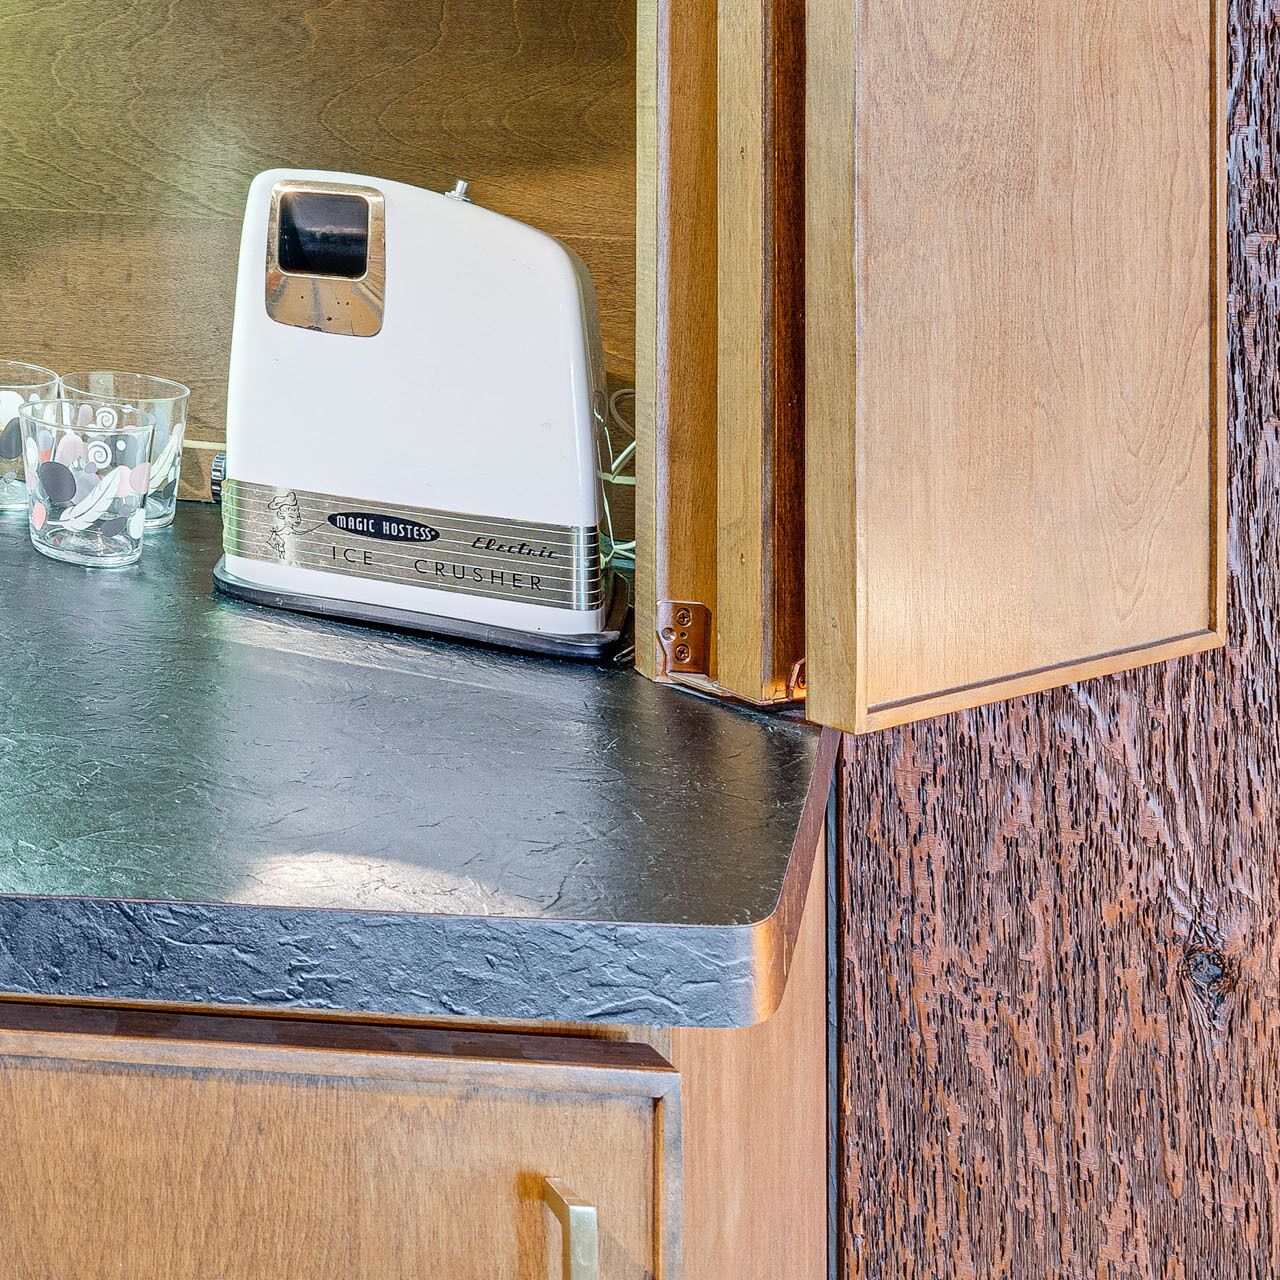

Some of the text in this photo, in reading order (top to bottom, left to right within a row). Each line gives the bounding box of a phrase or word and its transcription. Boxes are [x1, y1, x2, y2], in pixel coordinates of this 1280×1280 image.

[336, 515, 433, 541] MAGIC HOSTESS
[471, 536, 560, 560] Electric
[331, 546, 543, 592] ICE CRUSHER
